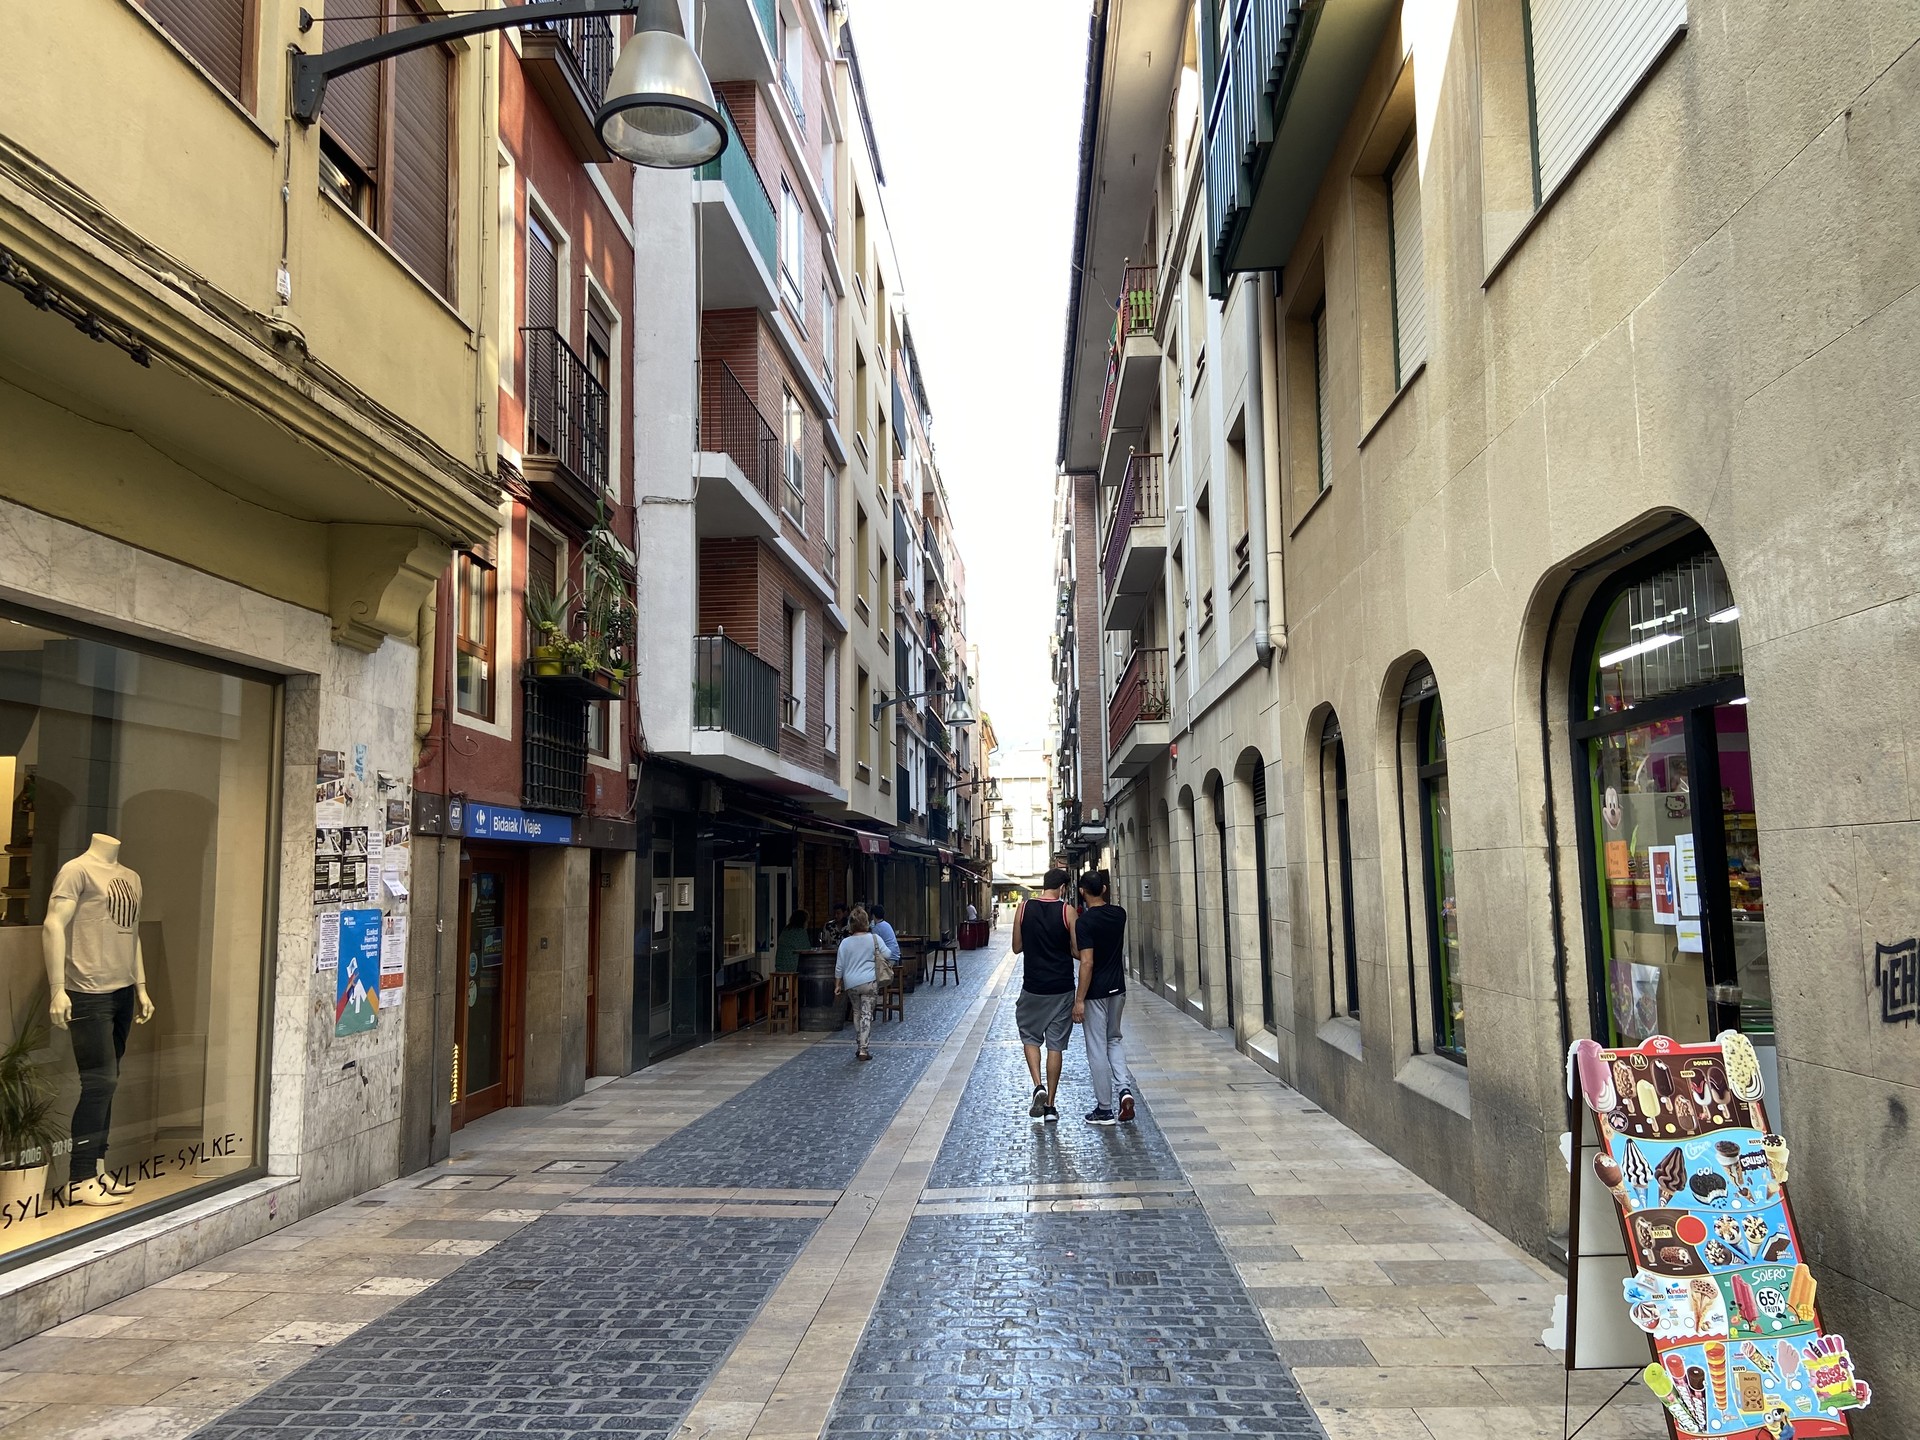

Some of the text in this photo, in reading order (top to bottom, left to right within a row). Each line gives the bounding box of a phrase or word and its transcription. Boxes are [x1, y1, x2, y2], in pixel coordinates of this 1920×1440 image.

[493, 816, 519, 833] Bidaiak
[523, 818, 542, 838] Viajes
[19, 1138, 73, 1166] 2006 2016
[1740, 1154, 1767, 1167] CRUSH
[1696, 1167, 1713, 1176] GO!
[2, 1133, 237, 1229] SYLKE SYLKE SYLKE
[1751, 1268, 1787, 1286] SOLERO
[1758, 1290, 1783, 1307] 65%
[1764, 1305, 1782, 1314] FRUTA
